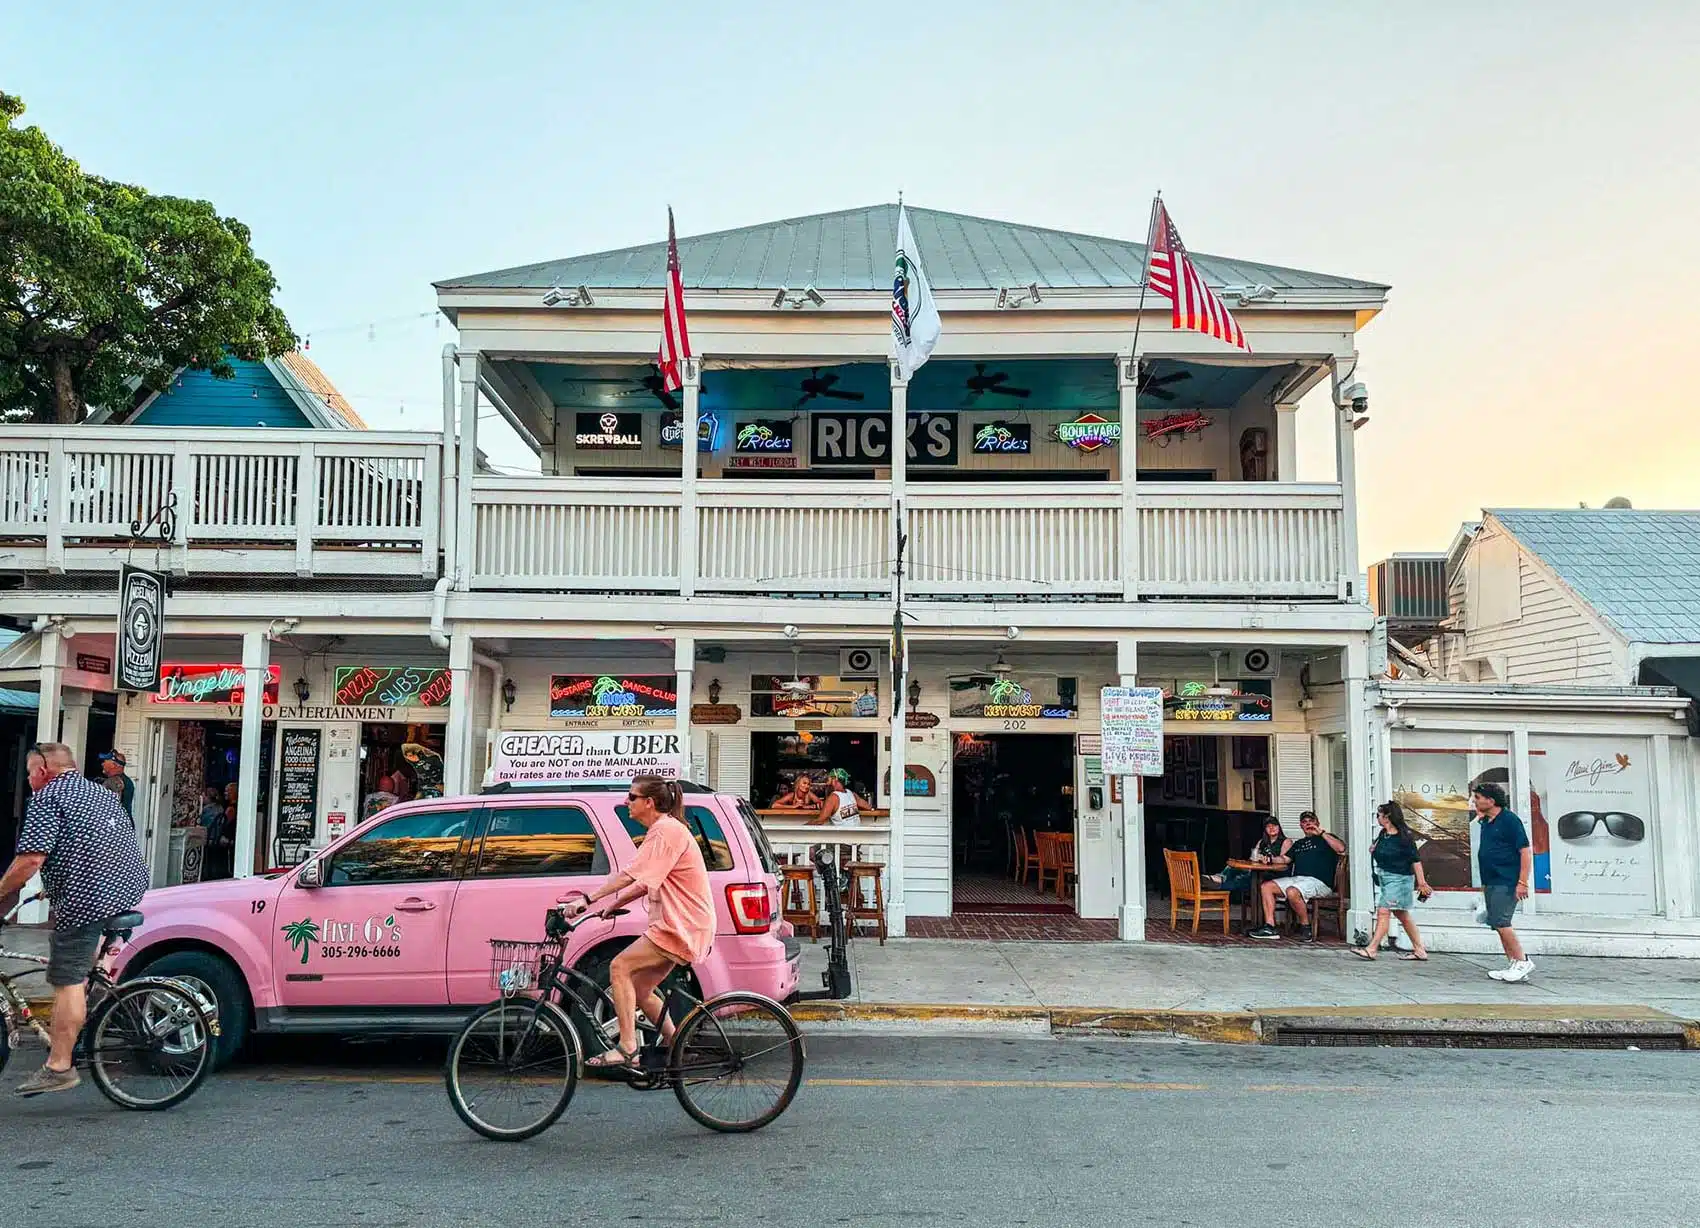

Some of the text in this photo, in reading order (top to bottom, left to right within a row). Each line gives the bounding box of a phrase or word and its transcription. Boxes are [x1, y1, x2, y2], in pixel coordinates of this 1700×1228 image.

[1061, 424, 1120, 437] BOULEVARD
[575, 434, 642, 444] SKREWBALL
[743, 434, 792, 449] Rick's
[979, 436, 1028, 451] Rick's
[335, 667, 381, 706] PIZZA
[379, 667, 420, 706] SUBS
[551, 680, 592, 700] UPSTAIRS
[621, 680, 677, 702] DANCE CLUB
[231, 691, 271, 703] PIA
[228, 705, 396, 720] VIO ENTERTAINMENT
[585, 705, 645, 716] KEY WEST
[984, 705, 1042, 717] KEY WEST
[1175, 709, 1235, 720] KEY WEST
[1003, 720, 1026, 730] 202
[501, 735, 681, 756] CHEAPER than UBER
[510, 759, 525, 768] You
[530, 760, 546, 768] are
[549, 759, 568, 767] NOT
[587, 758, 602, 767] the
[500, 771, 517, 779] taxi
[520, 771, 544, 779] rates
[564, 770, 579, 778] the
[583, 769, 611, 778] SAME
[627, 768, 676, 778] CHEAPER
[1565, 758, 1615, 786] Maui Jim
[1398, 784, 1458, 793] ALOHA
[250, 901, 266, 914] 19
[321, 945, 401, 958] 305-296-6666
